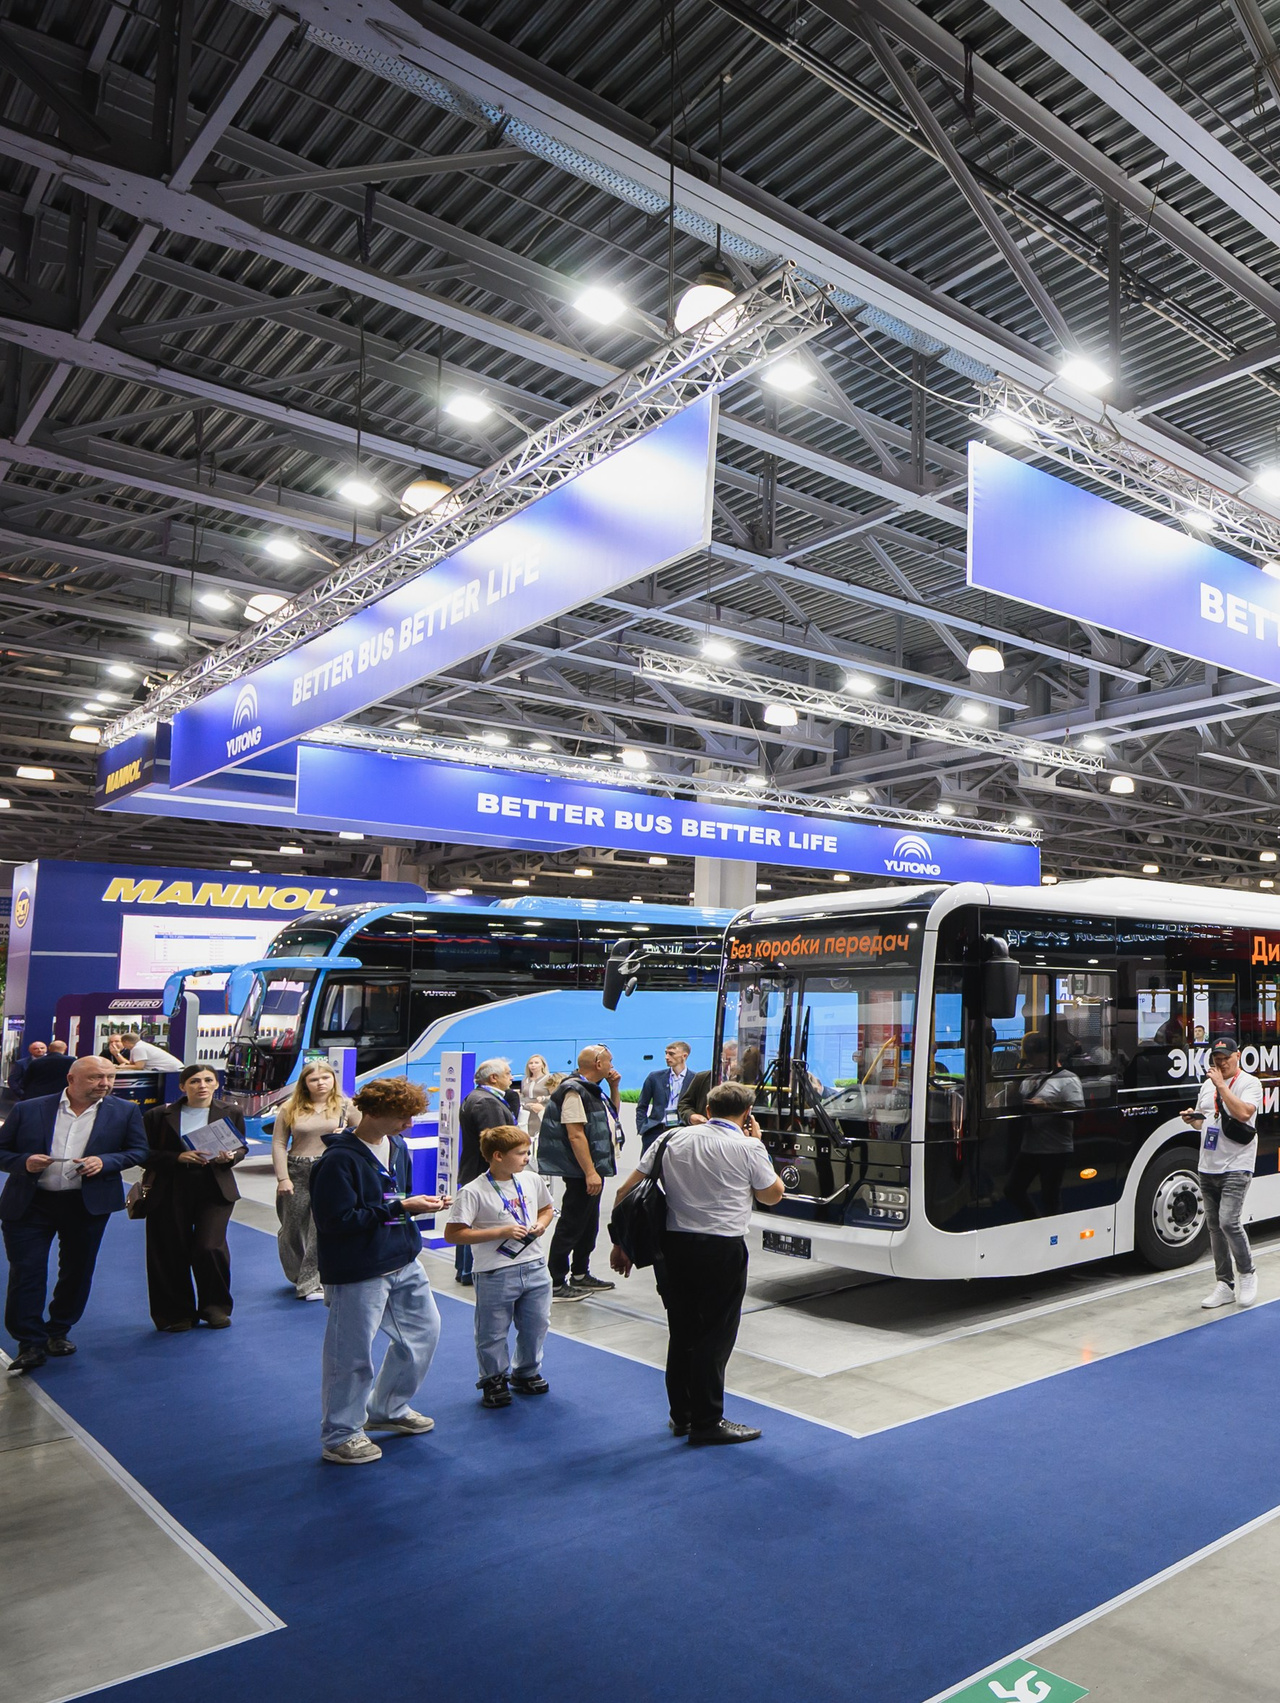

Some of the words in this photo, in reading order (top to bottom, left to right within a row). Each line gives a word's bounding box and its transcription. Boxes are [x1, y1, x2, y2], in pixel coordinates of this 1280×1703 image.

[292, 650, 354, 707] BETTER
[357, 627, 394, 674] BUS
[398, 579, 481, 652] BETTER
[486, 550, 541, 606] LIFE
[226, 726, 262, 758] YUTONG
[105, 760, 141, 794] MANNOL
[477, 792, 605, 828] BETTER
[614, 813, 673, 834] BUS
[682, 819, 781, 847] BETTER
[788, 832, 838, 854] LIFE
[883, 859, 941, 877] YUTONG
[102, 877, 337, 912] MANNOL
[731, 939, 751, 959] Без
[755, 935, 820, 961] коробки
[825, 934, 909, 957] передач
[1121, 1106, 1158, 1117] YUTONG
[769, 1141, 829, 1153] UTONG
